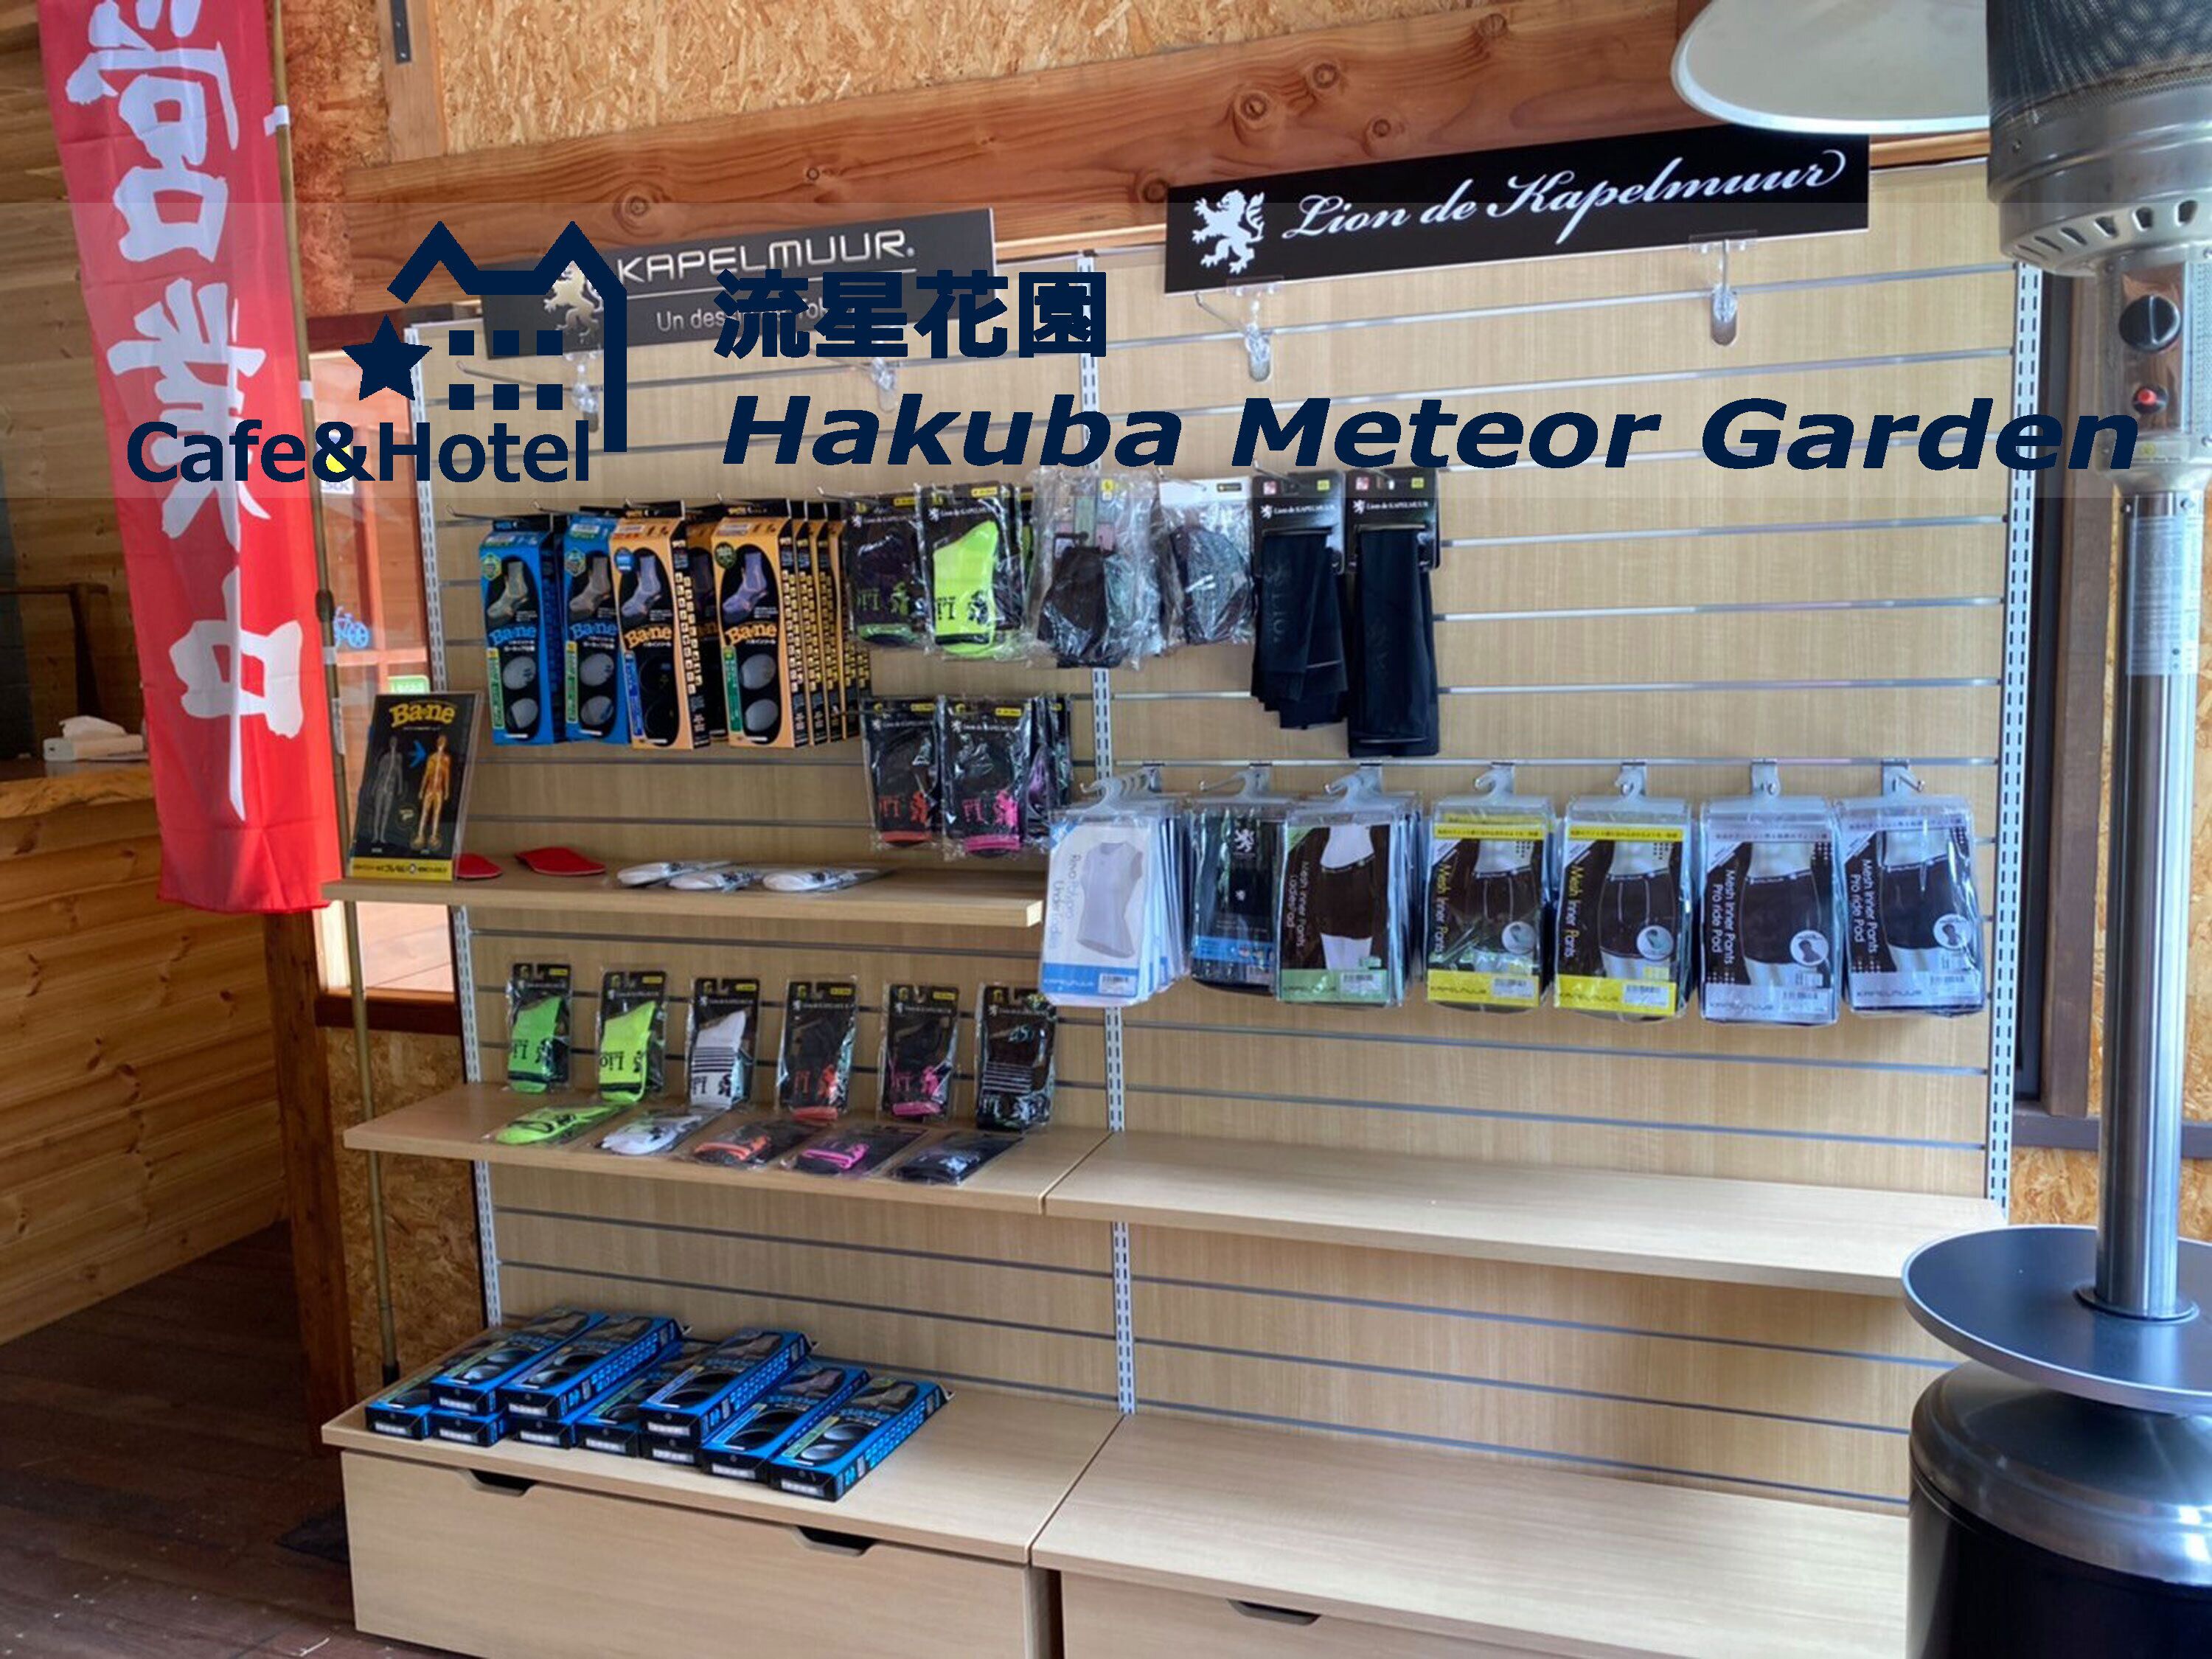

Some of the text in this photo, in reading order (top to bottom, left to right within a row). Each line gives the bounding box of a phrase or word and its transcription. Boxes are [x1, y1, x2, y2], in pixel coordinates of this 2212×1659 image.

[1281, 149, 1848, 246] Lion de Kapelmuur
[656, 311, 684, 332] Un
[65, 0, 303, 821] 営業中
[624, 627, 673, 649] Bane
[726, 624, 777, 646] Bane
[388, 703, 456, 728] Bane
[1564, 866, 1583, 958] Mesh Inner Pants
[1711, 883, 1723, 953] Pro ride Pad
[1724, 869, 1736, 964] Mesh Inner Pants
[1851, 874, 1865, 943] Pro ride Pad
[1862, 859, 1879, 953] Mesh Inner Pants
